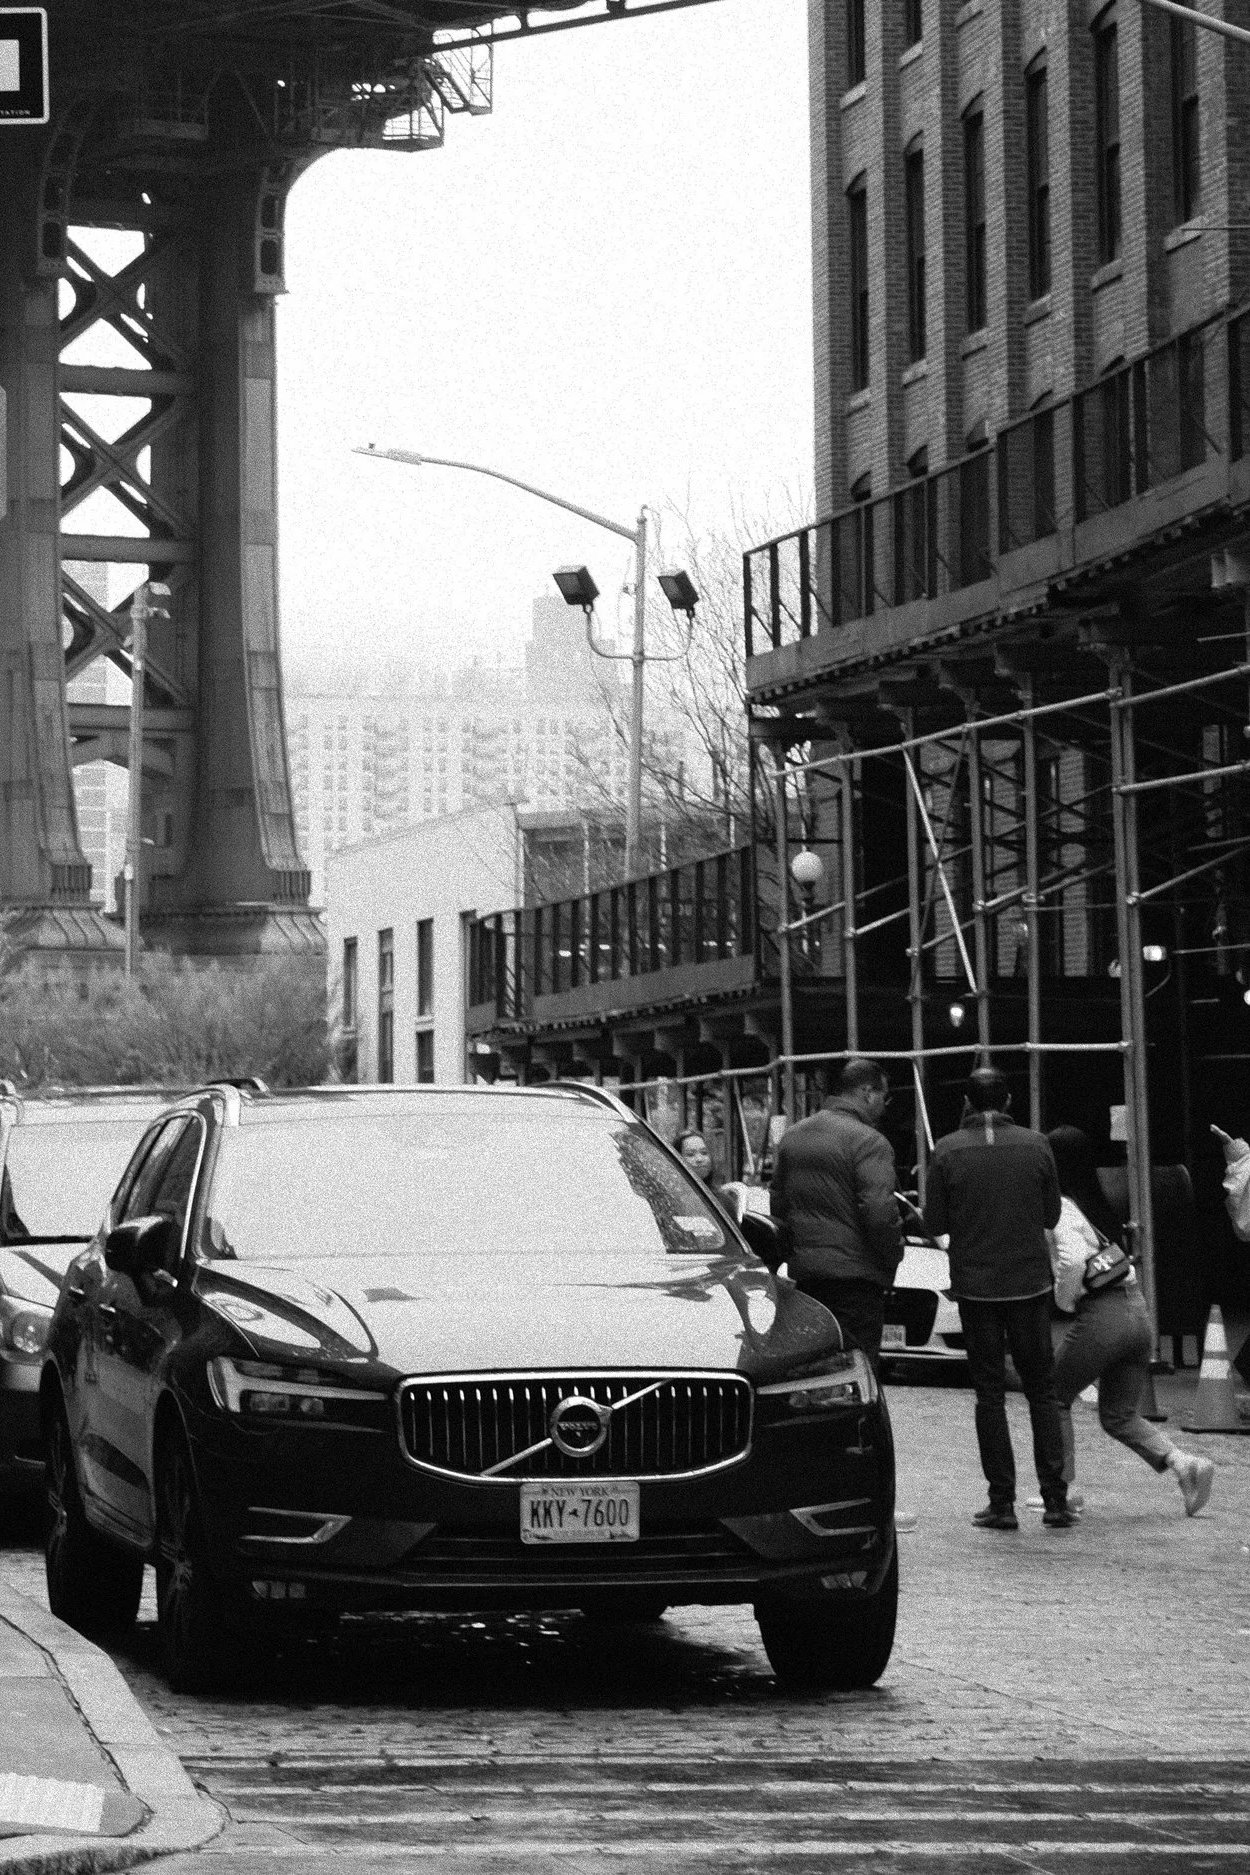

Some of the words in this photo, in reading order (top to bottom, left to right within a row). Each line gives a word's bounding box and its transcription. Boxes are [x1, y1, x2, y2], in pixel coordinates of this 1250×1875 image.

[551, 1487, 576, 1497] NEW
[580, 1486, 610, 1496] YORK
[530, 1499, 567, 1528] KKY
[581, 1498, 630, 1528] 7600
